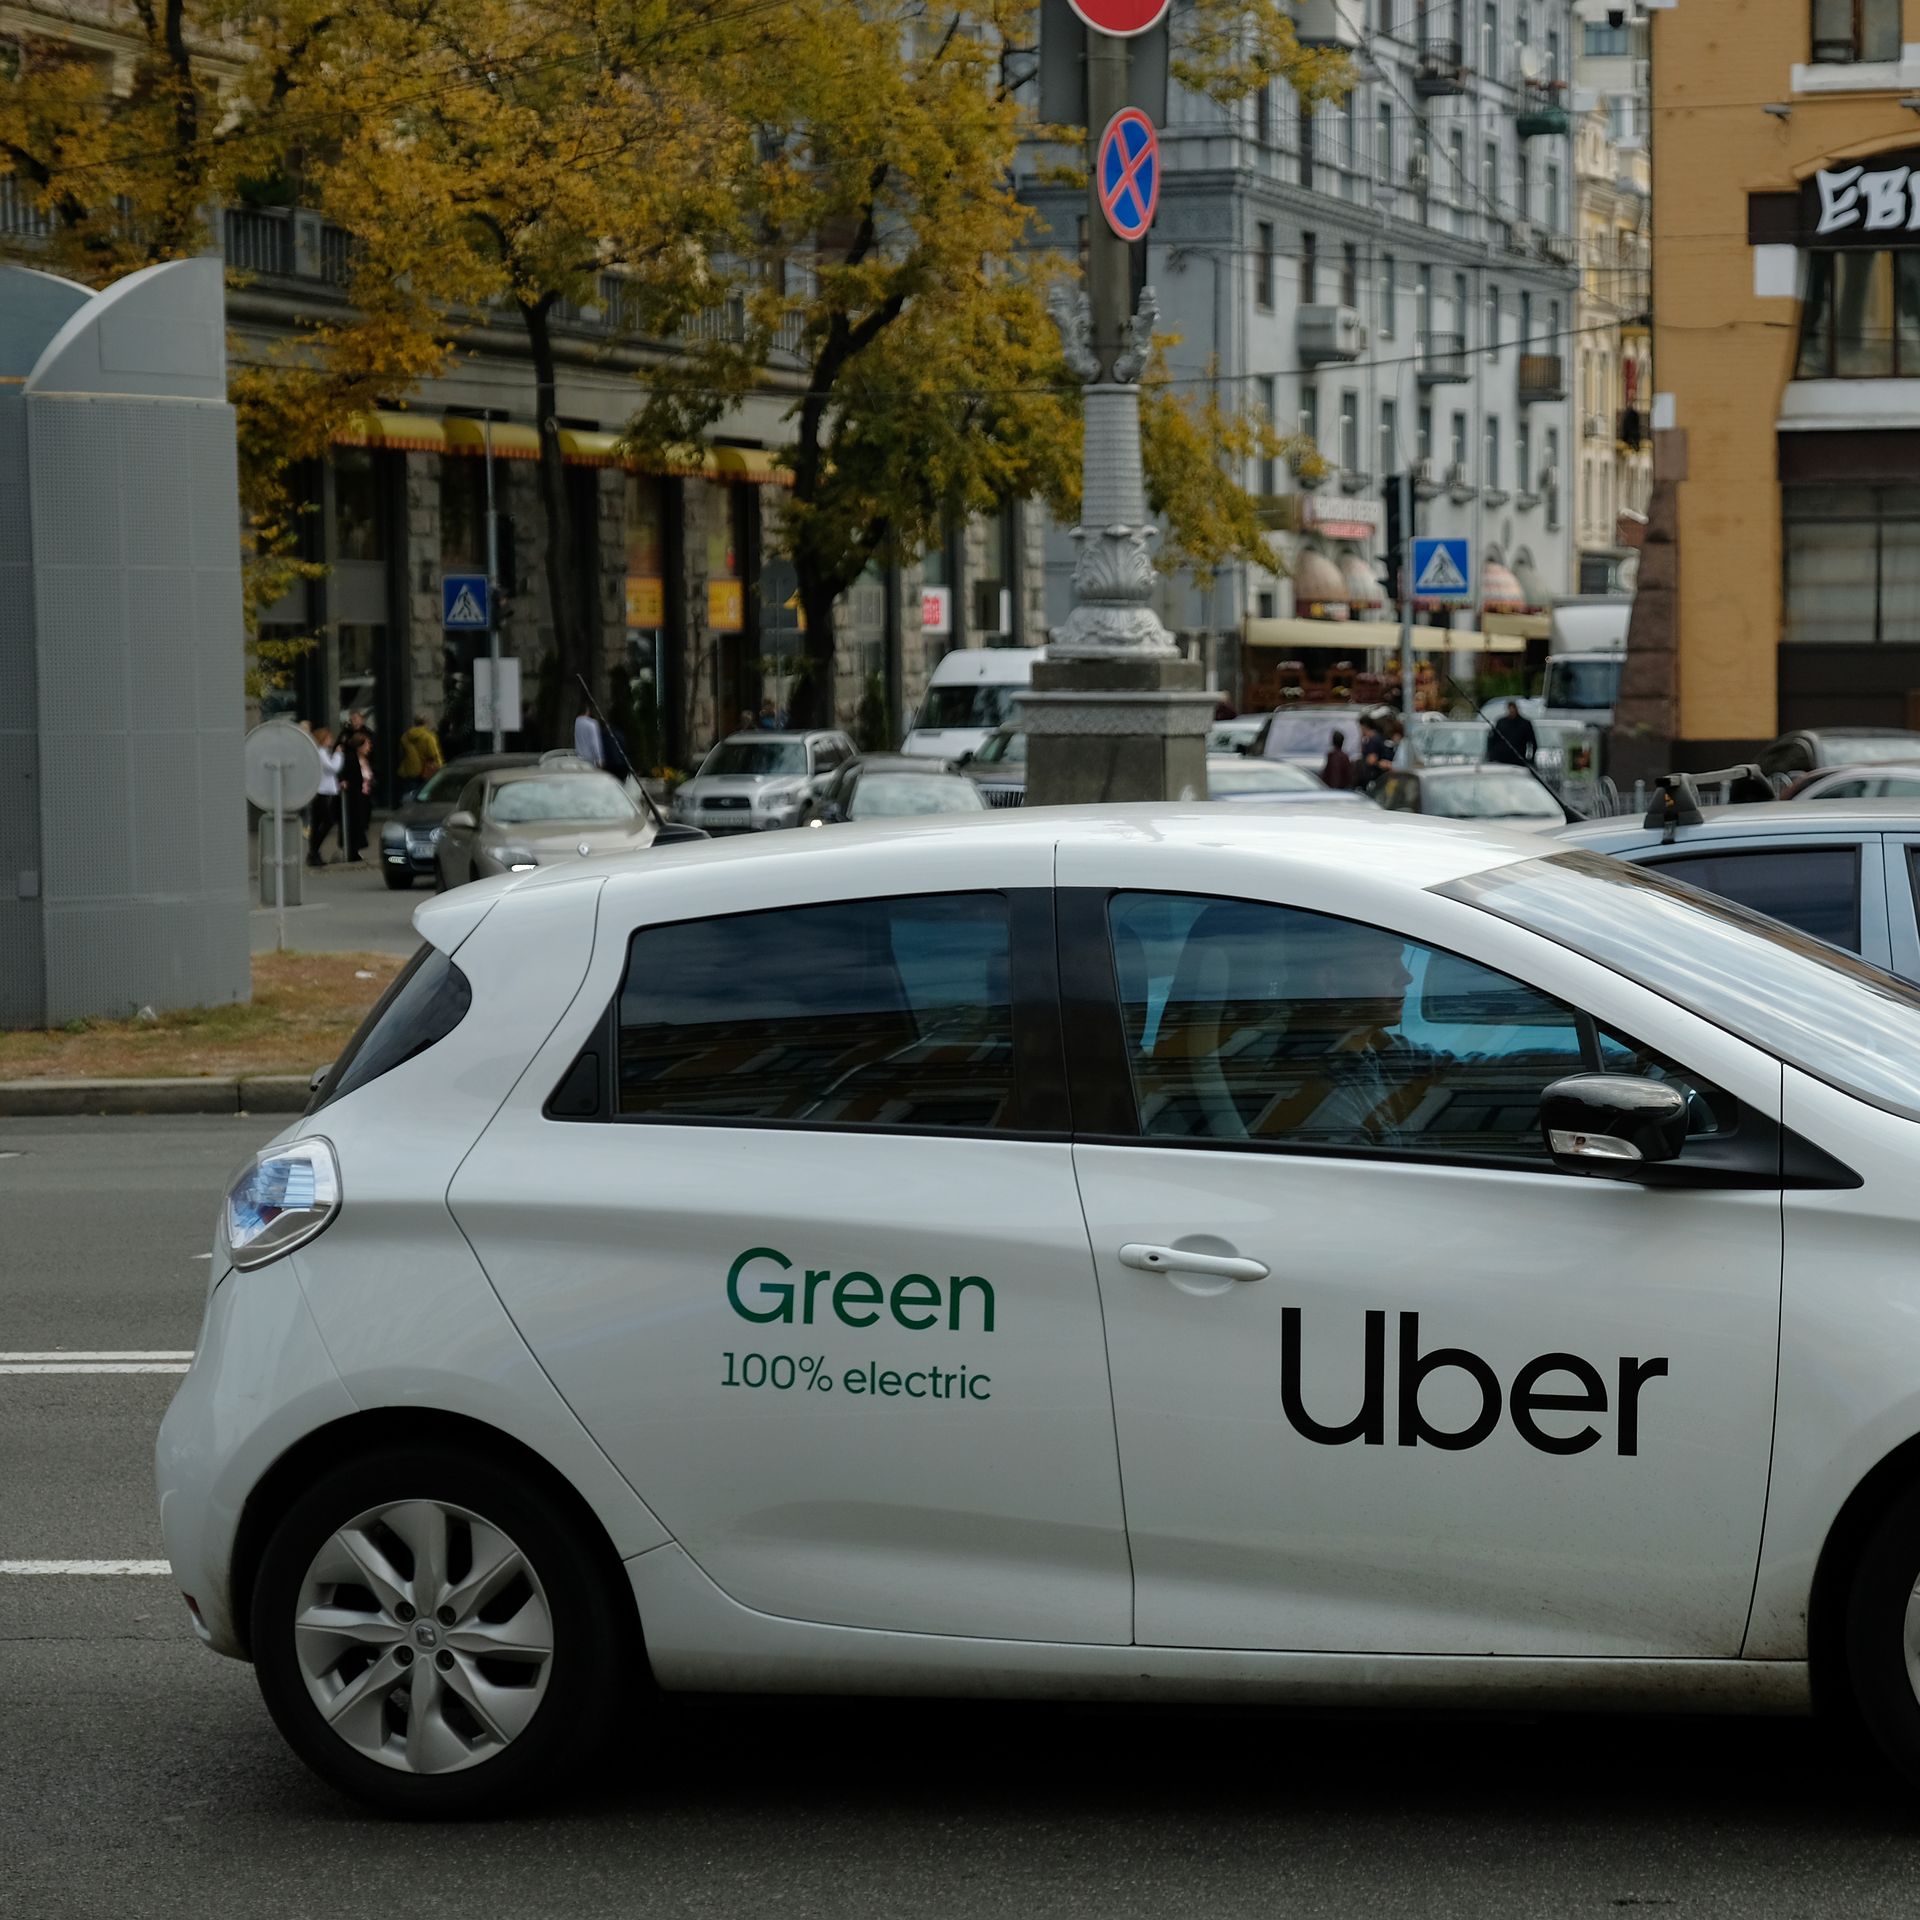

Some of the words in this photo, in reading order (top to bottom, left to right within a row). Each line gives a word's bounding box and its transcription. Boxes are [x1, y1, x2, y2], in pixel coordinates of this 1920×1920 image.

[1816, 165, 1920, 234] ЕВ
[726, 1246, 995, 1333] Green
[720, 1351, 834, 1393] 100%
[842, 1360, 992, 1401] electric
[1280, 1306, 1669, 1457] Uber
